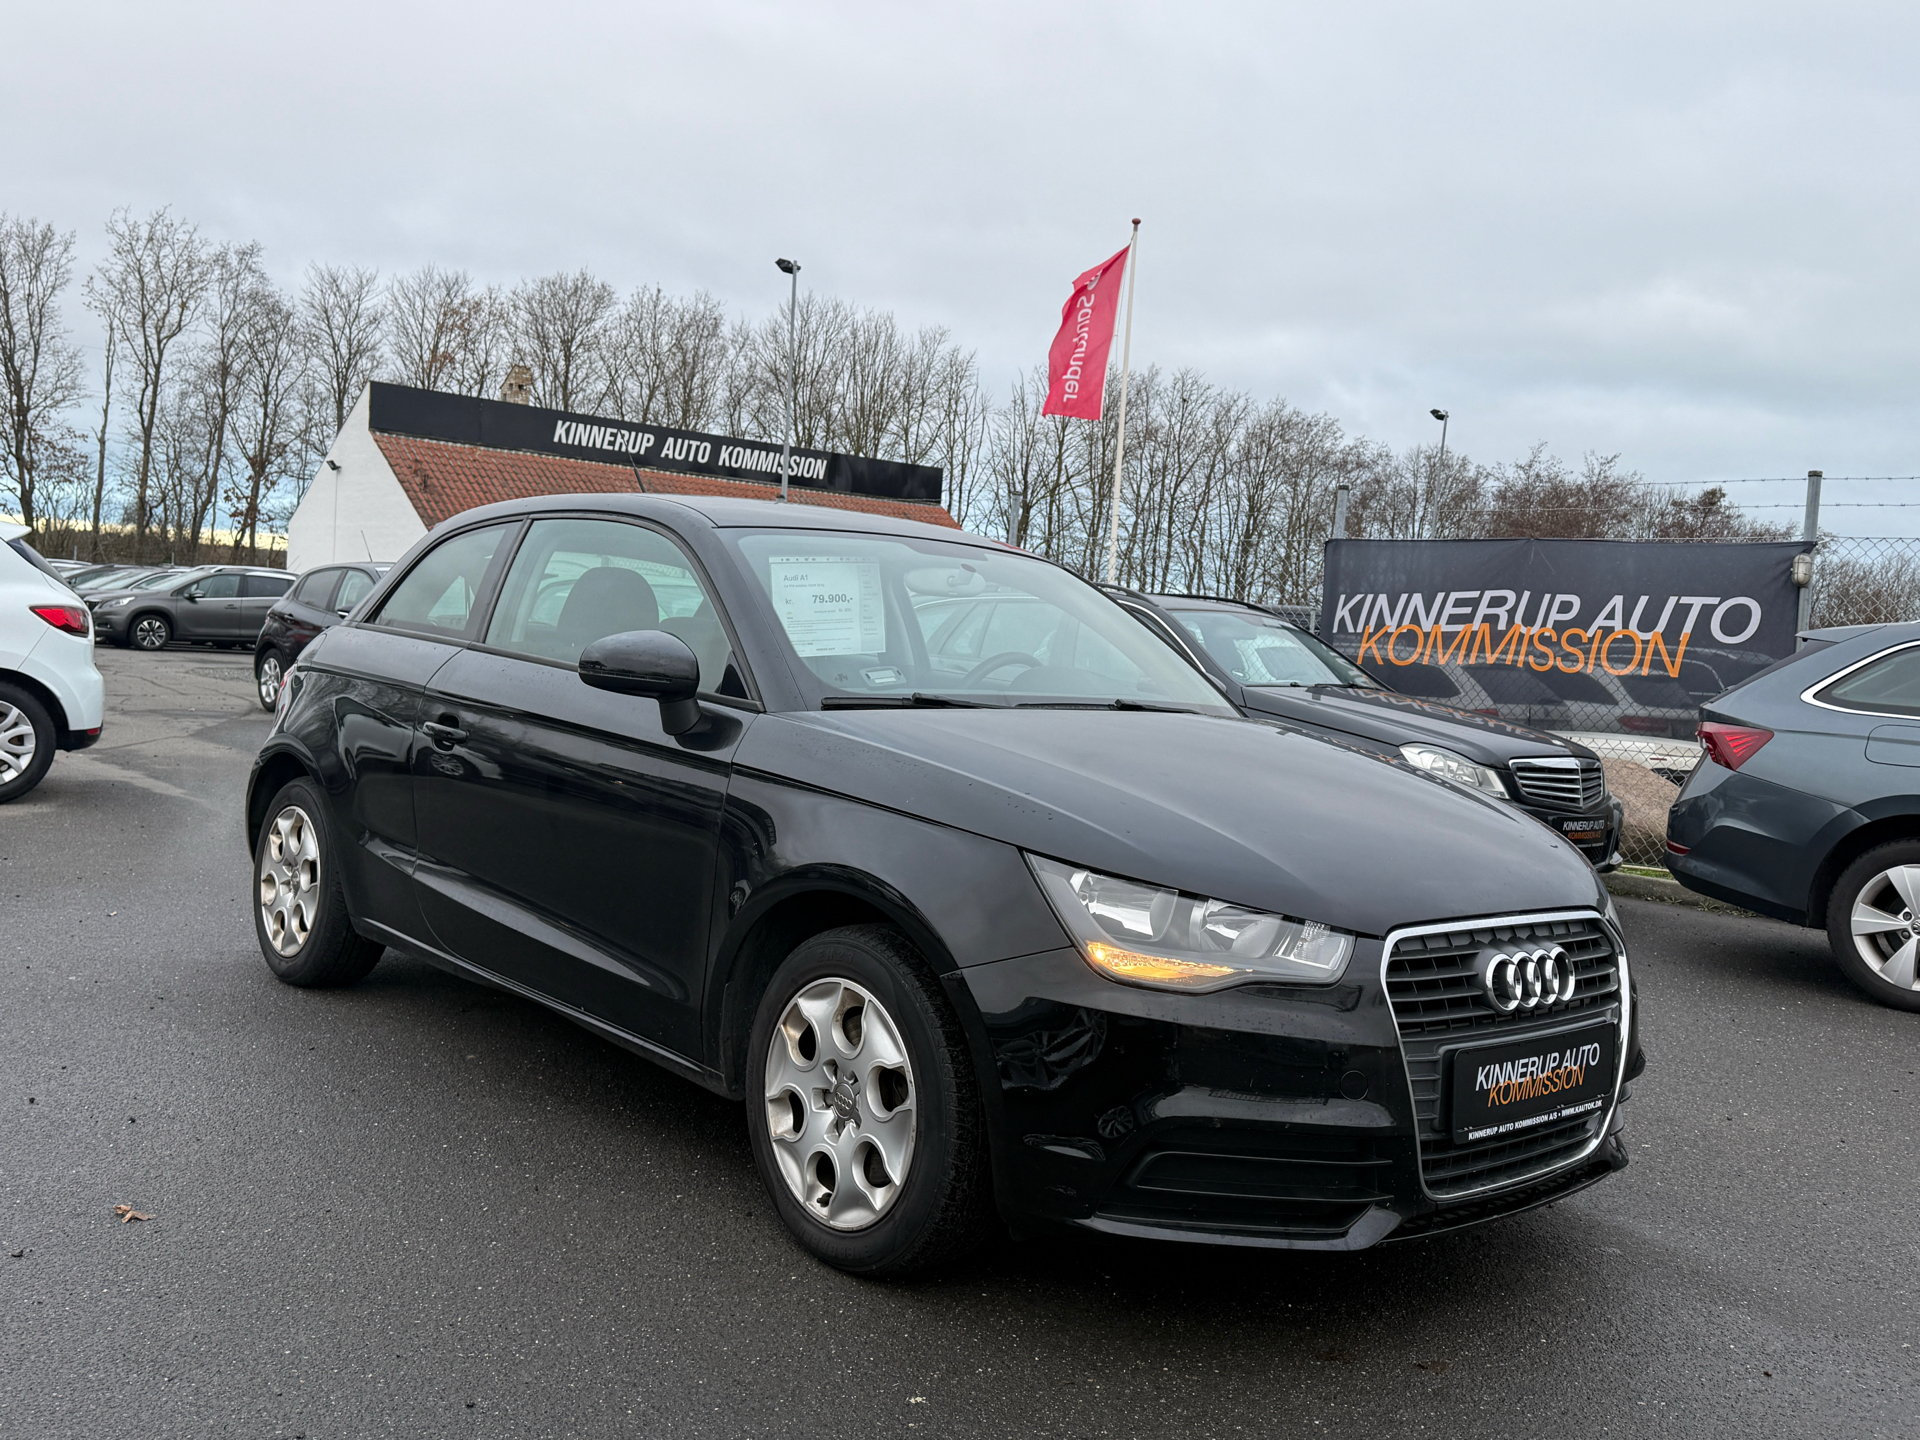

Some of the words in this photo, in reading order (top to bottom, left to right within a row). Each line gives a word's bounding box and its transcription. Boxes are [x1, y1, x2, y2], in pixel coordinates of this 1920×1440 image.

[553, 420, 655, 455] KINNERUP
[660, 437, 711, 464] AUTO
[718, 445, 827, 480] KOMMISSION
[812, 593, 853, 604] 79.900,-
[1332, 589, 1581, 637] KINNERUP
[1586, 594, 1762, 645] AUTO
[1356, 622, 1691, 679] KOMMISSION
[1563, 821, 1593, 830] KINNERUP
[1475, 1052, 1559, 1091] KINNERUP
[1560, 1043, 1600, 1073] AUTO
[1488, 1064, 1585, 1107] KOMMISSION
[1468, 1125, 1499, 1140] KINNERUP
[1498, 1122, 1514, 1133] AUTO
[1514, 1113, 1549, 1129] KOMMISSION
[1548, 1111, 1558, 1120] A/S
